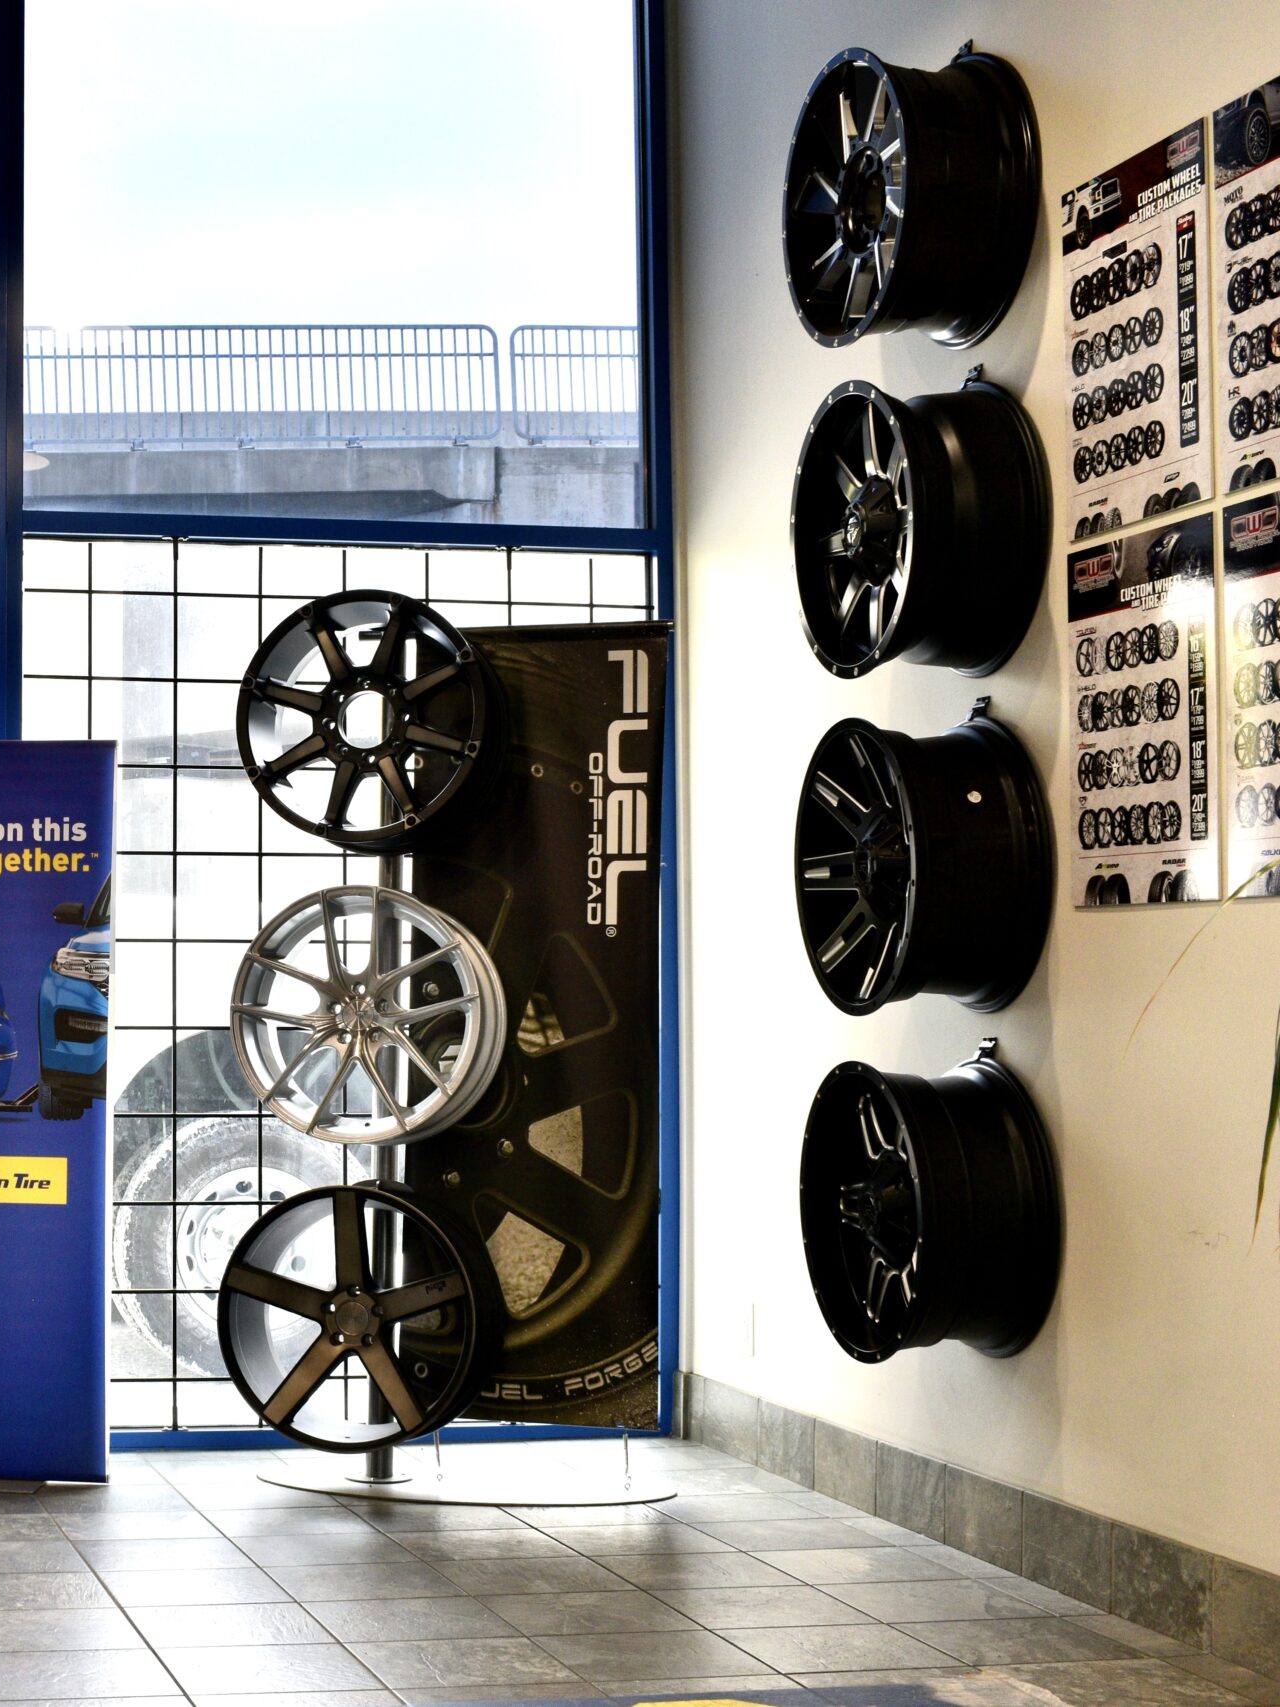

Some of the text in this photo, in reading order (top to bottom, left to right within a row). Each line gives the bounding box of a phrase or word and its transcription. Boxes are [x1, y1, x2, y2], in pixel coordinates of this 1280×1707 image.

[1137, 163, 1201, 208] CUSTOM WHEEL
[1138, 201, 1156, 224] TIRE
[1157, 179, 1202, 215] PACKAGES
[1120, 581, 1153, 602] CUSTOM
[1141, 594, 1159, 611] TIRE
[606, 649, 649, 925] FUEL
[32, 817, 88, 842] this
[586, 752, 604, 925] OFF-ROAD
[14, 1172, 51, 1190] Tire
[480, 1383, 544, 1400] UEL
